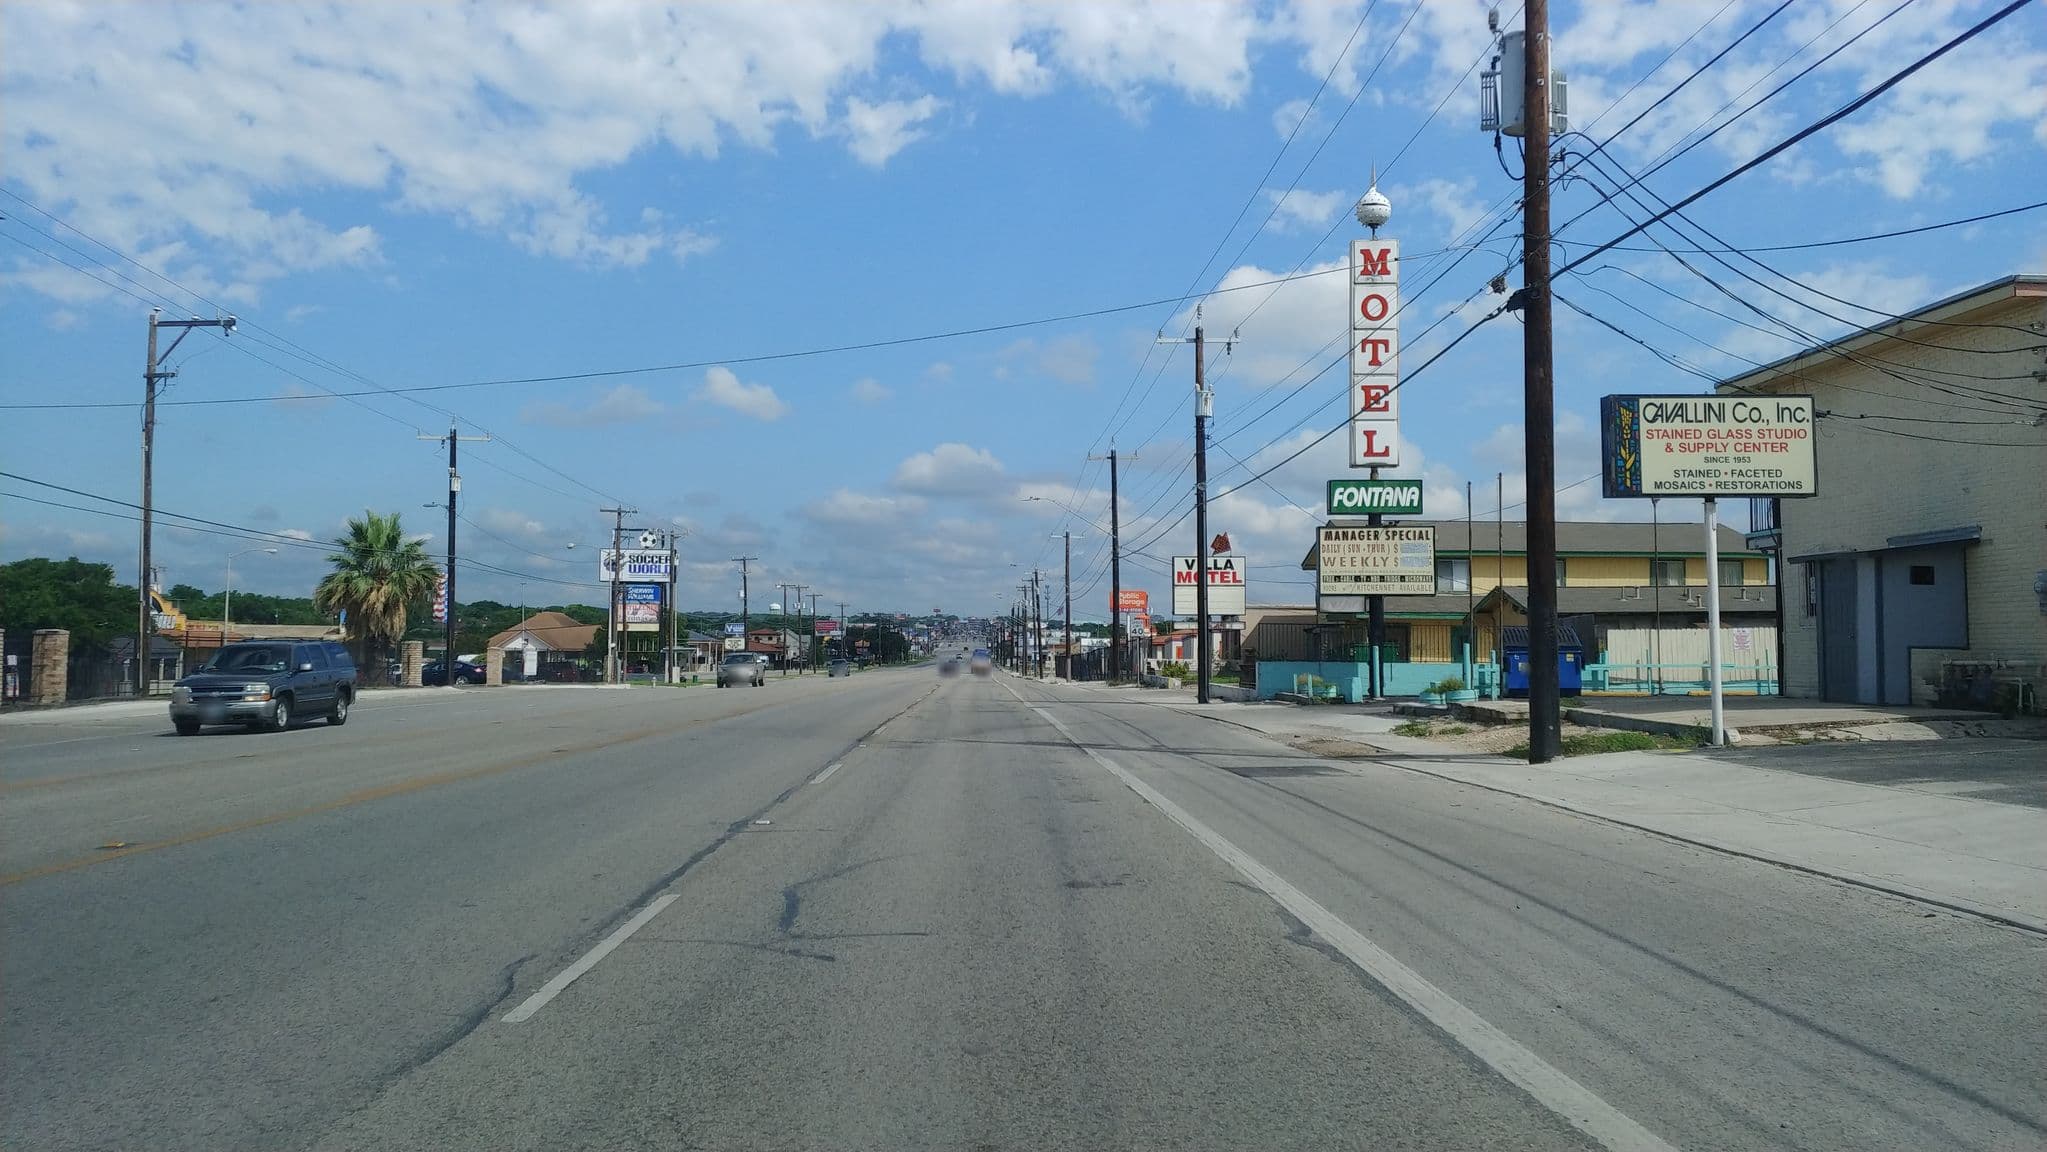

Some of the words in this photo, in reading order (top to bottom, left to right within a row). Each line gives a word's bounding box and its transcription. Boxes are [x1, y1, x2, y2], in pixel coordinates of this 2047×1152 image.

[1359, 248, 1392, 457] MOTEL
[1642, 401, 1726, 423] CAVALLINI
[1732, 401, 1770, 426] Co.,
[1776, 402, 1810, 423] Inc.
[1646, 428, 1703, 440] STAINED
[1707, 428, 1753, 440] GLASS
[1757, 428, 1808, 440] STUDIO
[1664, 442, 1674, 453] &
[1678, 442, 1729, 453] SUPPLY
[1734, 442, 1789, 453] CENTER
[1703, 456, 1730, 464] SINCE
[1733, 456, 1752, 464] 1953
[1673, 469, 1721, 478] STAINED
[1731, 469, 1783, 478] FACETED
[1654, 481, 1706, 490] MOSAICS
[1715, 481, 1803, 490] RESTORATIONS
[1332, 486, 1420, 508] FONTANA
[1324, 530, 1380, 541] MANAGER
[1384, 530, 1430, 541] SPECIAL
[1321, 544, 1341, 553] DAILY
[1184, 559, 1235, 571] VLA
[1322, 556, 1389, 567] WEEKLY
